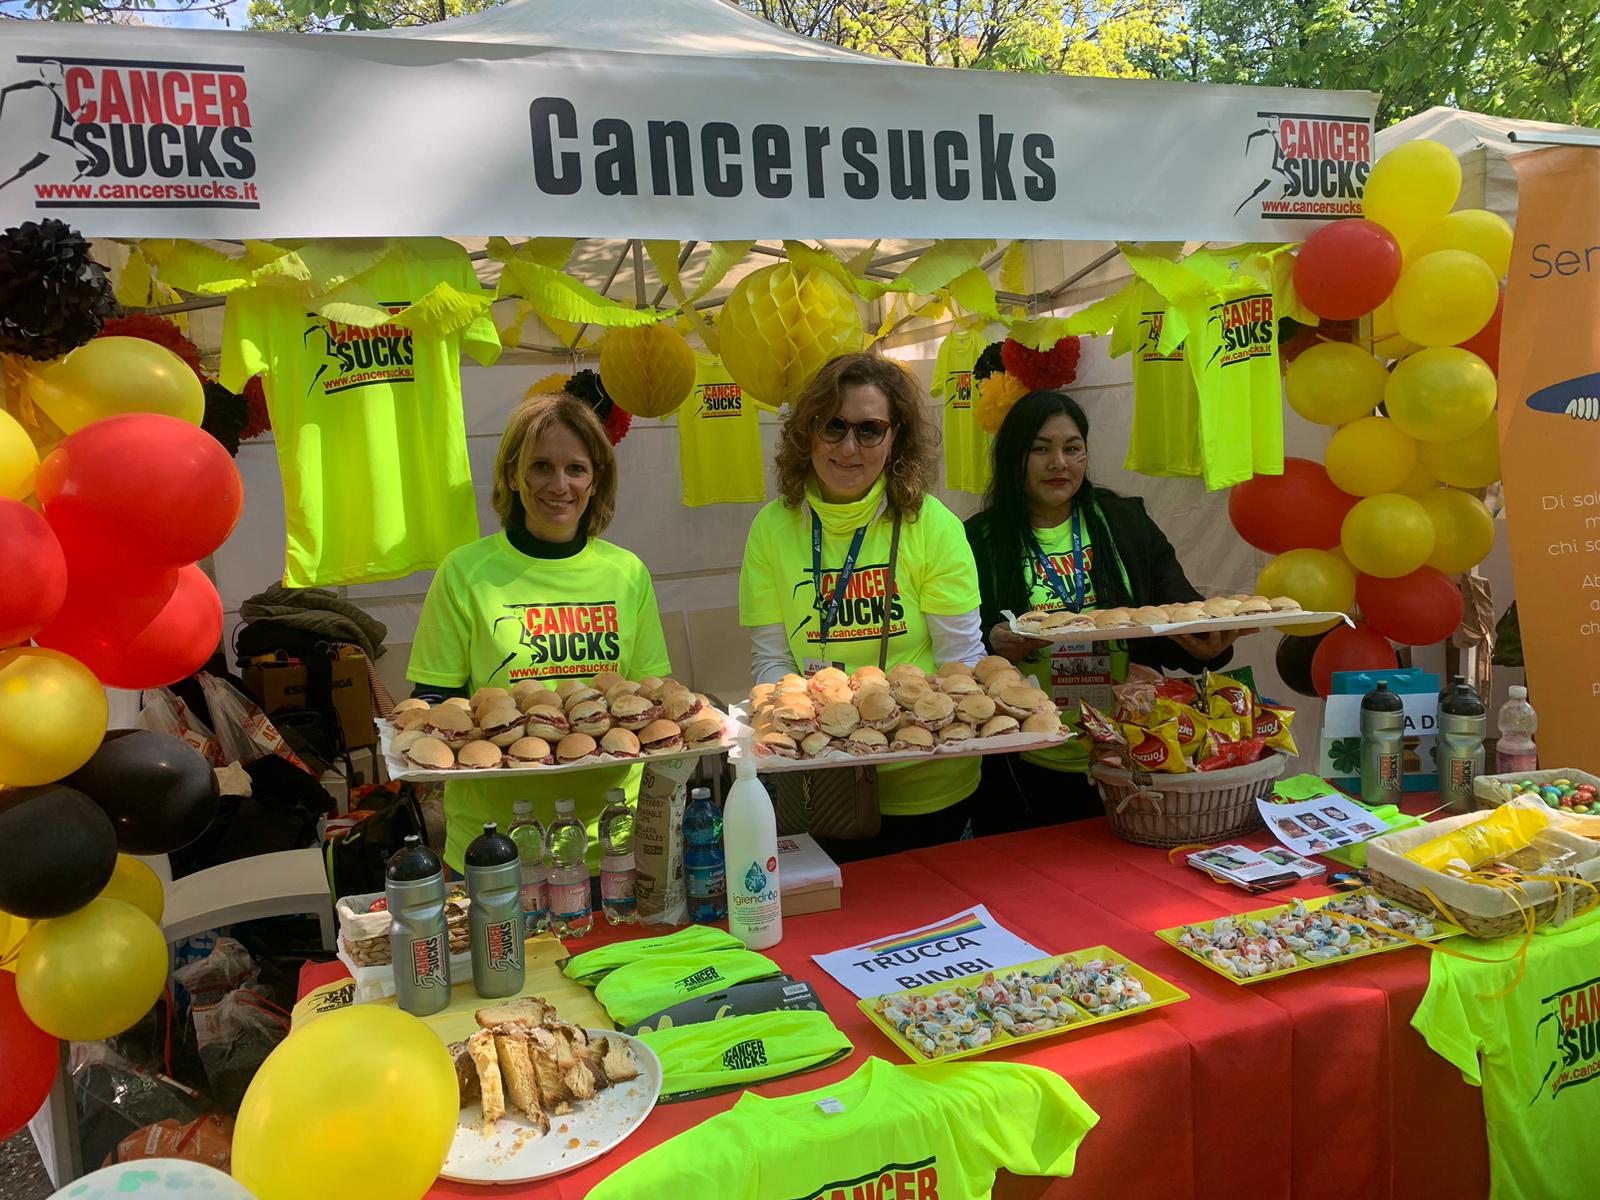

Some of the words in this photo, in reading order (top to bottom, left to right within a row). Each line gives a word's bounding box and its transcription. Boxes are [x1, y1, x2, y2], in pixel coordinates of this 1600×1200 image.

[65, 67, 251, 128] CANCER
[73, 122, 256, 179] SUCKS
[529, 96, 1057, 202] Cancersucks
[1280, 119, 1370, 162] CANCER
[34, 180, 258, 200] www.cancersucks.it
[1284, 158, 1370, 199] SUCKS
[1262, 200, 1363, 214] www.cancersucks
[1222, 297, 1273, 329] CANER
[1224, 320, 1273, 352] SUKS
[336, 336, 413, 372] SUCKS
[704, 385, 742, 398] CANCER
[706, 397, 742, 410] SUCKS
[1542, 494, 1566, 511] Di
[1548, 539, 1578, 556] chi
[526, 605, 619, 636] CANCER
[530, 631, 620, 664] SUCKS
[509, 662, 618, 678] www.cancersucks.it
[1178, 724, 1193, 737] zies
[1256, 719, 1279, 736] Fonz
[1422, 715, 1439, 730] D
[426, 937, 440, 974] SUCKS
[488, 924, 503, 961] CANCER
[500, 921, 513, 959] SUCKS
[852, 936, 981, 973] TRUCCA
[415, 941, 430, 976] CANCER
[895, 958, 994, 989] BIMBI
[684, 967, 719, 987] CANCER
[725, 1040, 766, 1060] CANCER
[1563, 1020, 1600, 1067] SU
[728, 1052, 768, 1070] SUCKS
